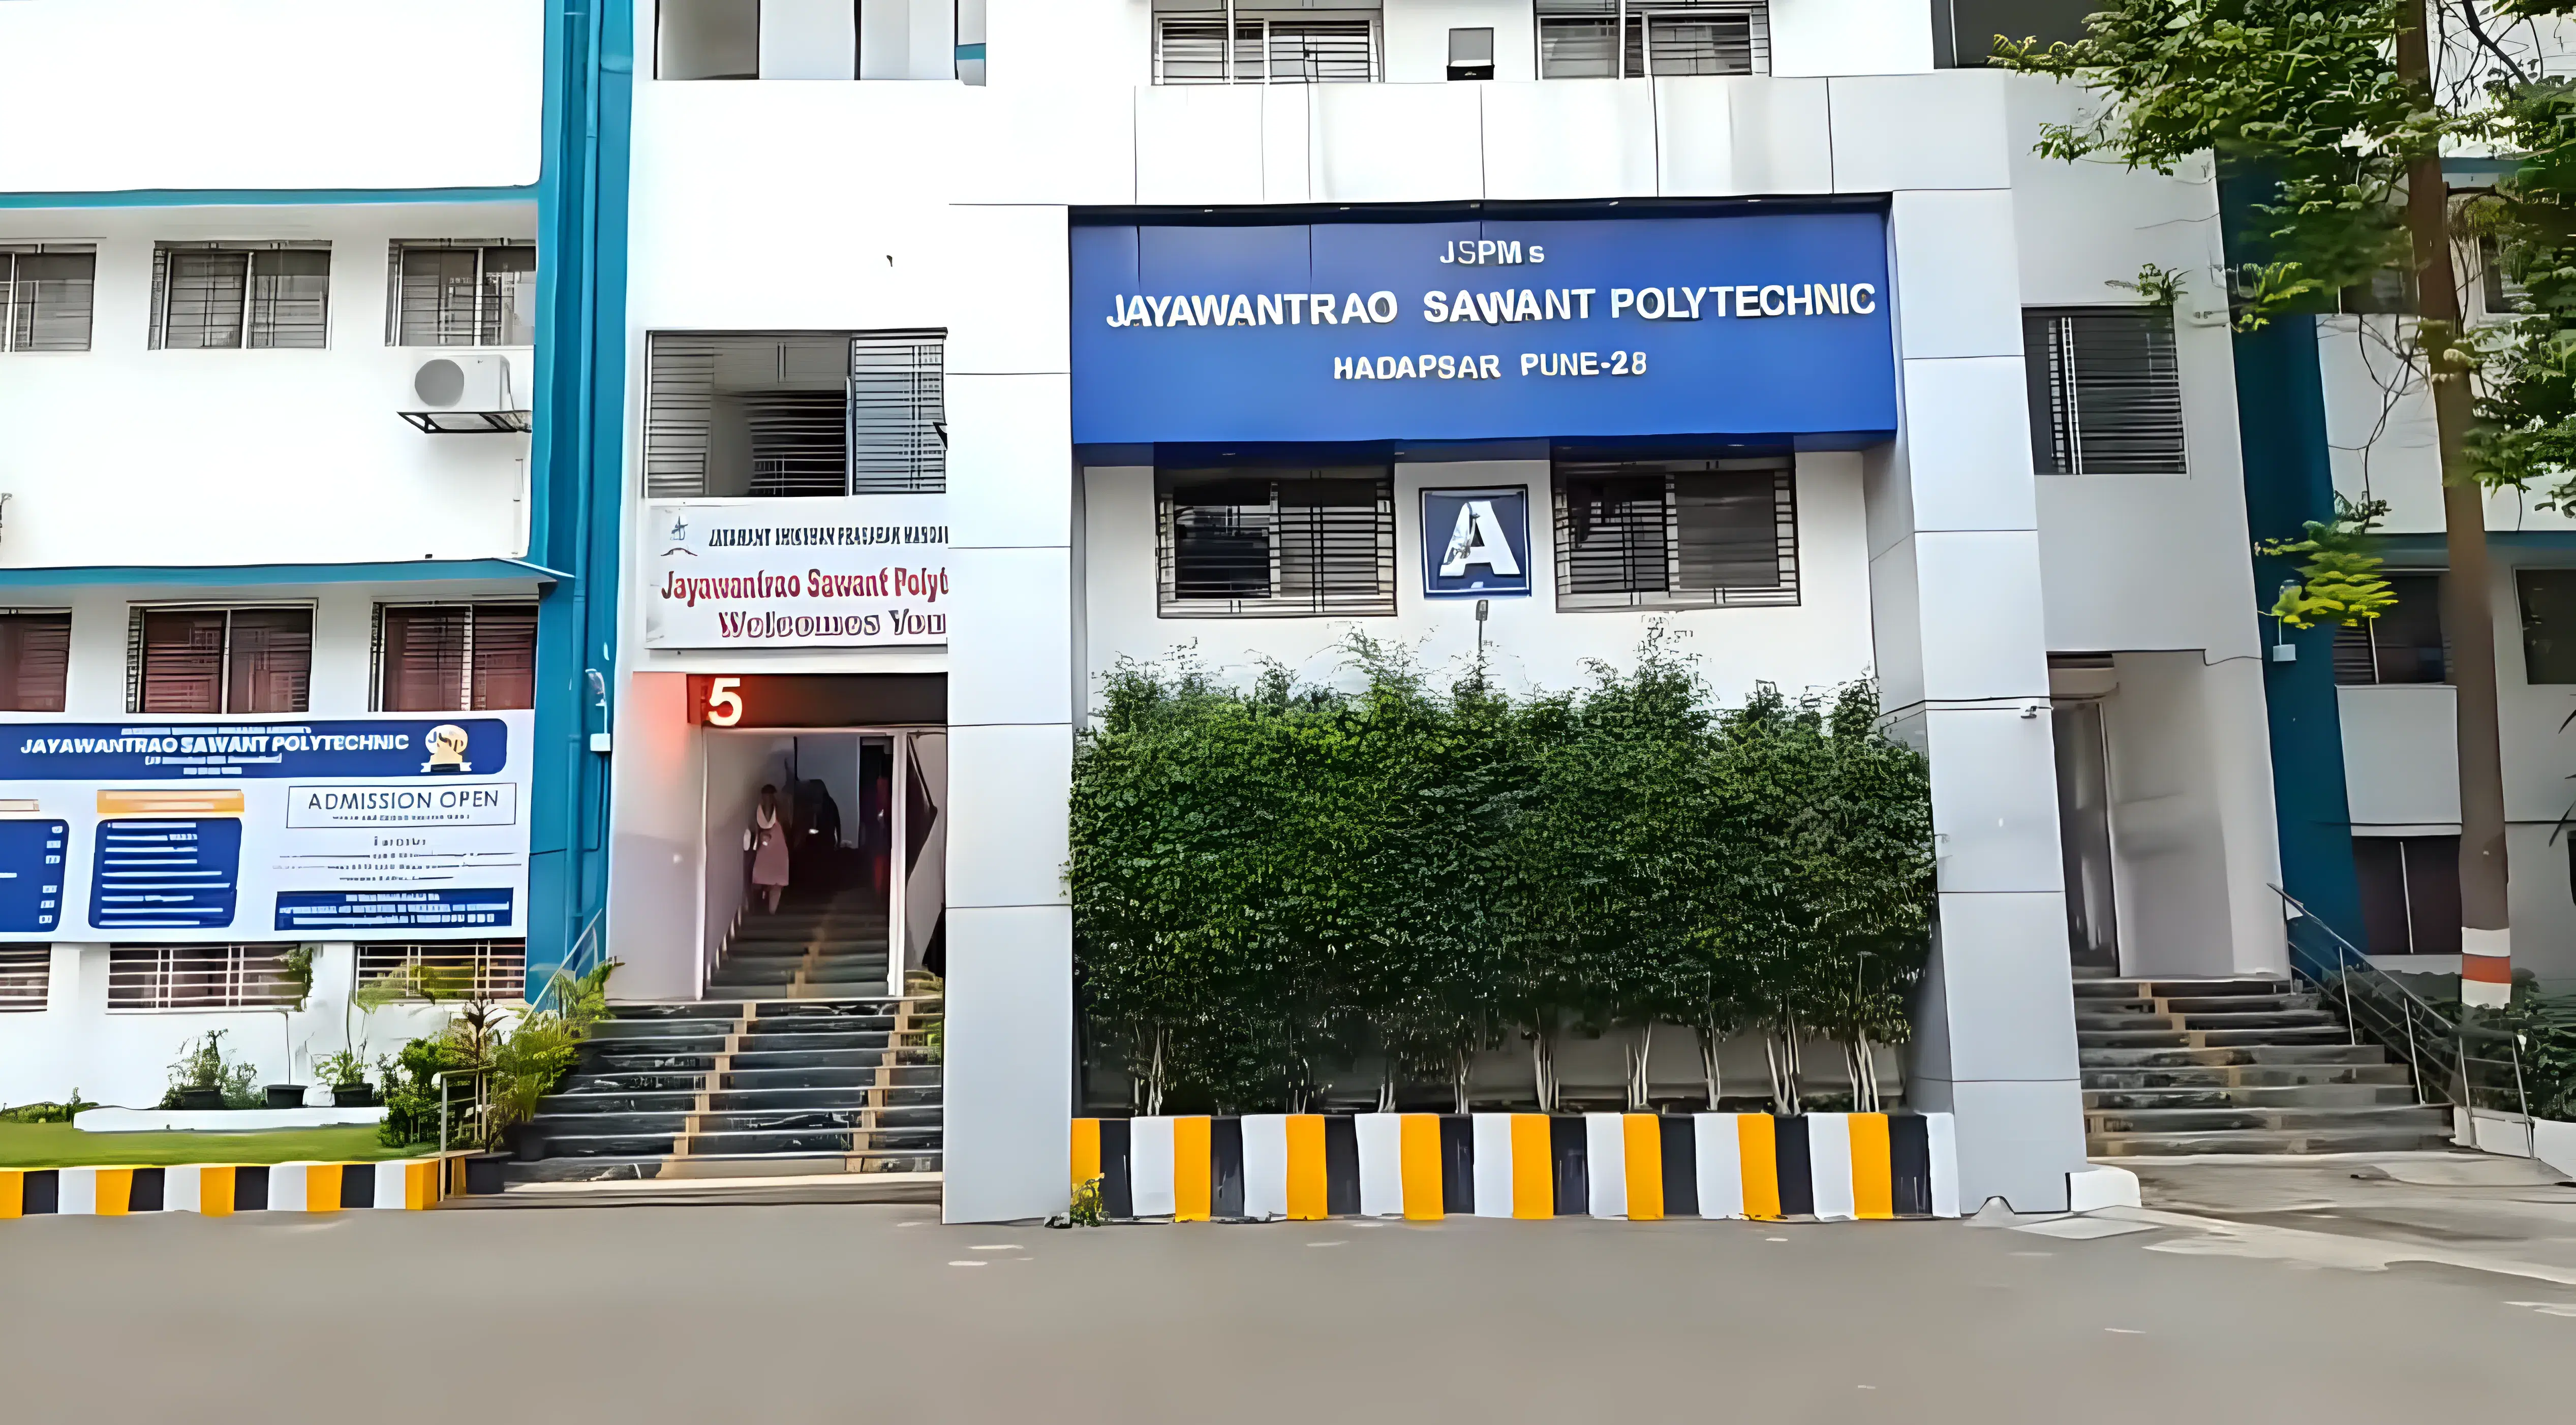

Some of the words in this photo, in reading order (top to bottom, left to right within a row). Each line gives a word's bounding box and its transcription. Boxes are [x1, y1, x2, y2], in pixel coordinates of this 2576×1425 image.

[1106, 291, 1398, 327] JAYAWANTRAO
[1423, 288, 1596, 324] SAWANT
[1611, 283, 1876, 319] POLYTECHNIC
[1334, 354, 1501, 380] HADAPSAR
[1520, 351, 1647, 376] PUNE-28
[1439, 501, 1520, 576] A
[807, 567, 888, 598] Sawant
[708, 678, 743, 726] 5
[20, 737, 178, 754] JAYAWANTRAO
[180, 736, 269, 753] SAWANT
[271, 734, 409, 752] POLYTECHNIC
[309, 792, 432, 810] ADMISSION
[440, 790, 498, 808] OPEN
